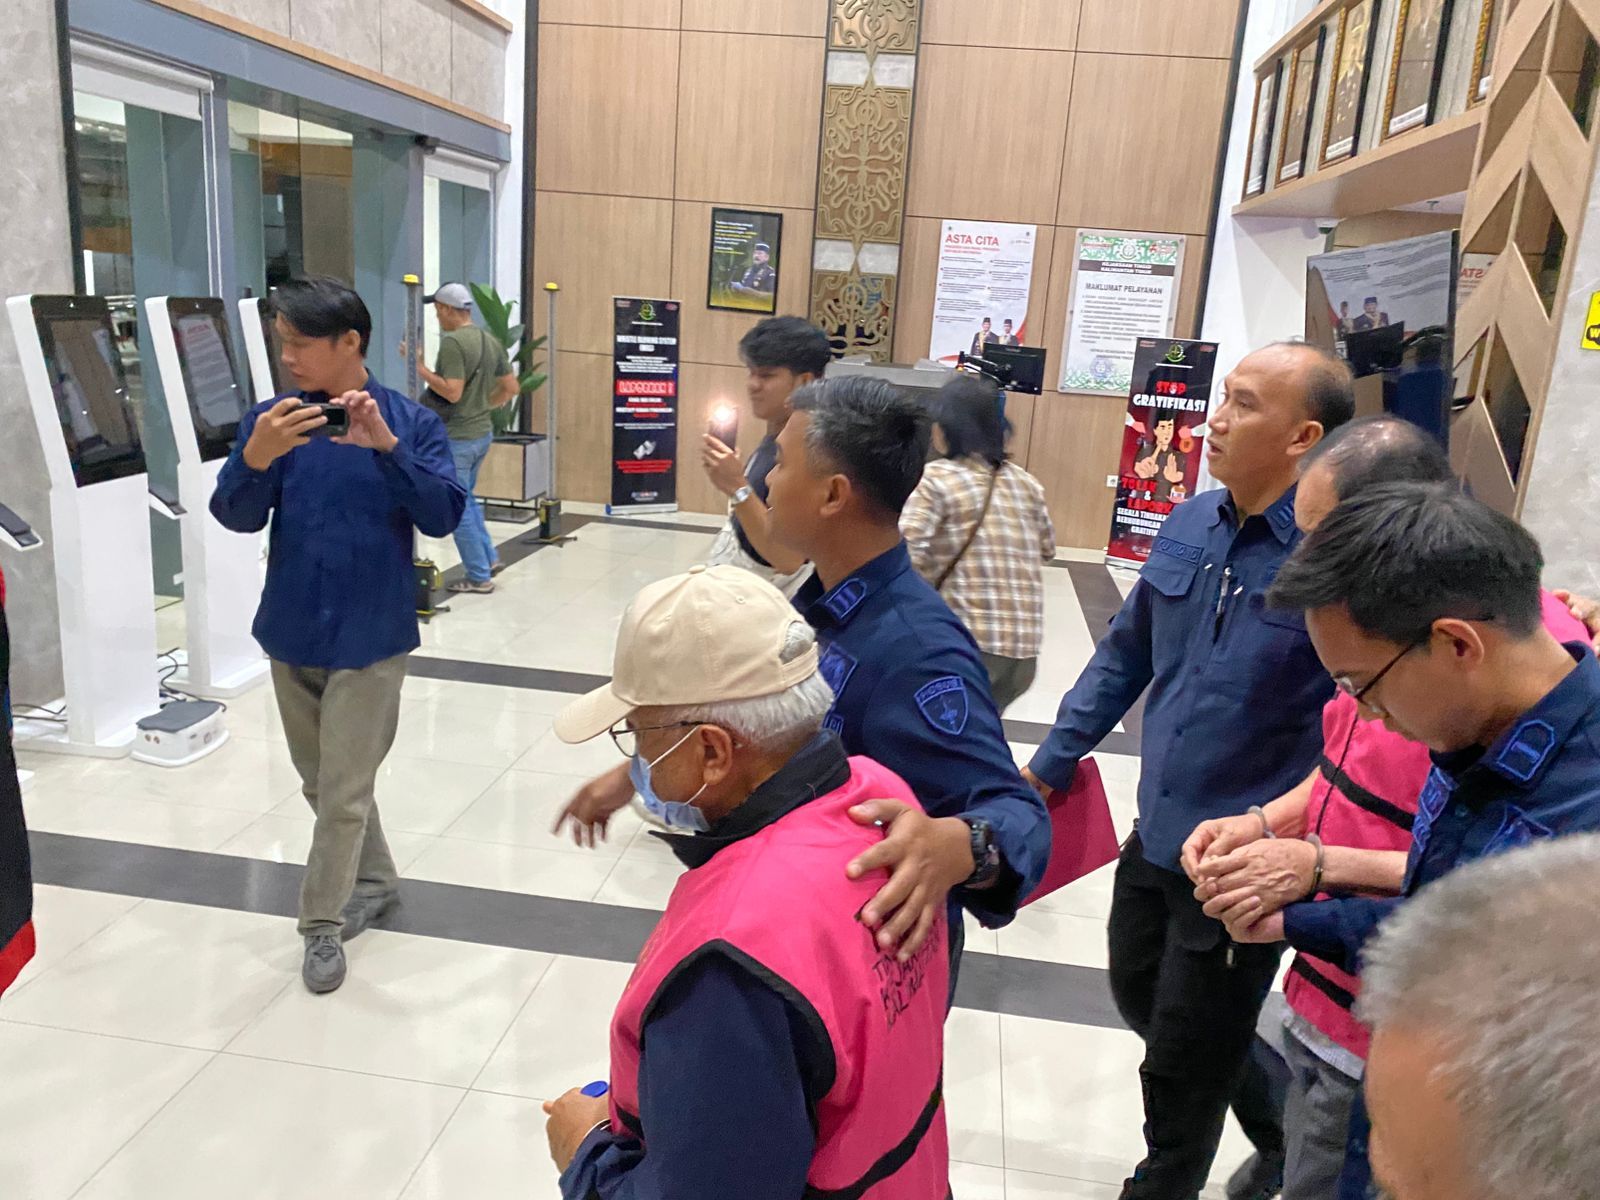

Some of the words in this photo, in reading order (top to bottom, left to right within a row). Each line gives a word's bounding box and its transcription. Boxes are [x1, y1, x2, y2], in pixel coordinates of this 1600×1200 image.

[945, 234, 973, 245] ASTA
[975, 235, 1000, 246] CITA
[1085, 282, 1123, 291] MAKLUMAT
[1123, 285, 1163, 294] PELAYANAN
[1156, 382, 1186, 395] STOP
[1133, 394, 1206, 412] GRATIFIKASI
